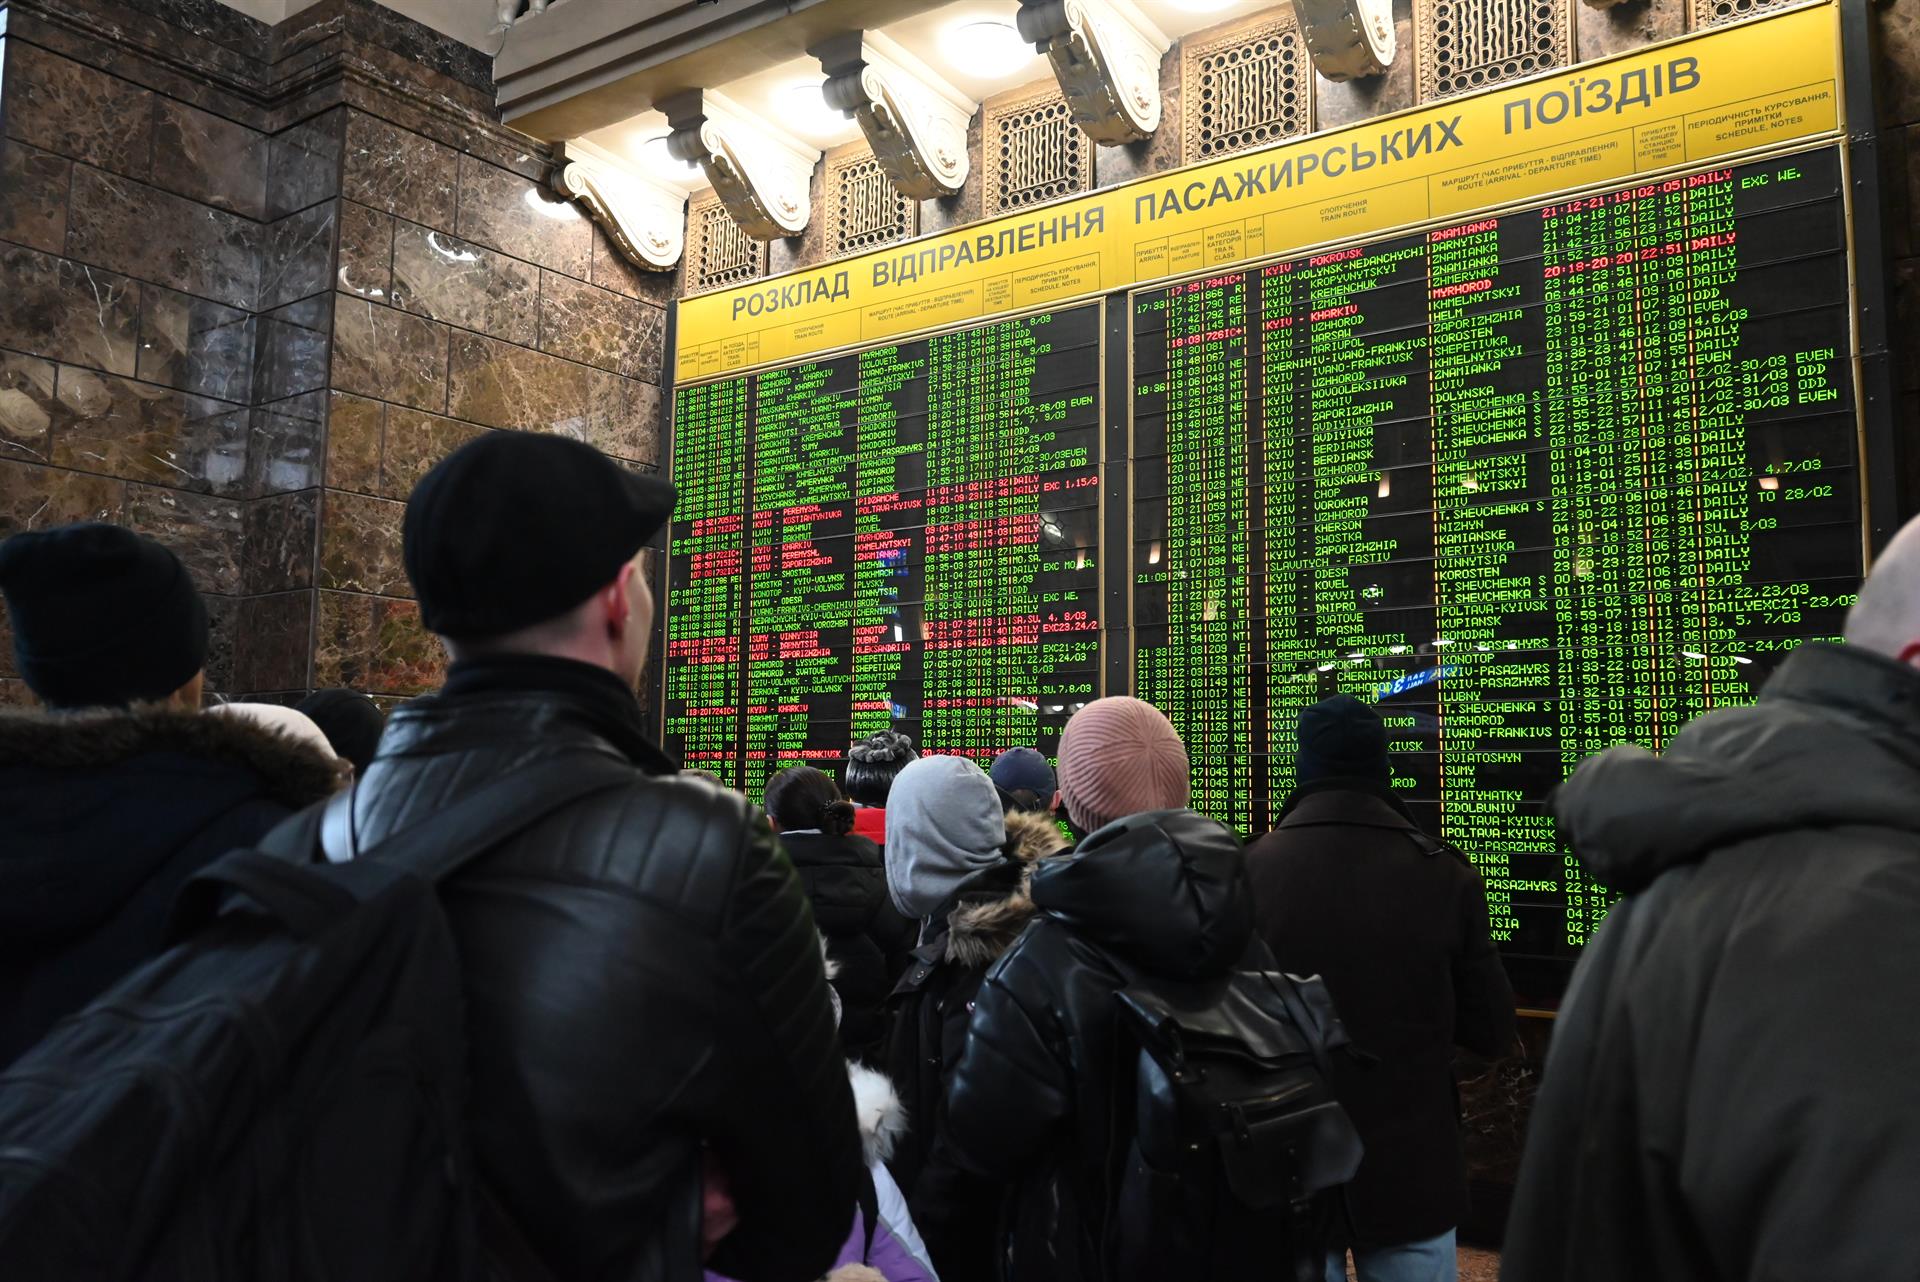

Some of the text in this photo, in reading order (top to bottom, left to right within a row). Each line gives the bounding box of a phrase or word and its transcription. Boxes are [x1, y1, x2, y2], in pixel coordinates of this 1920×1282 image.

[1688, 92, 1831, 130] ПЕРІОДИЧНІСТЬ КУРСУВАННЯ,
[1734, 112, 1782, 127] ПРИМІТКИ
[1642, 125, 1676, 136] ПРИБУТТЯ
[1716, 116, 1803, 141] SCHEDULE, NOTES
[1638, 144, 1681, 157] DESTINATION
[1442, 141, 1618, 187] МАРШРУТ (ЧАС ПРИБУТТЯ ВІДПРАВЛЕННЯ)
[1457, 154, 1601, 191] ROUTE (ARRIVAL DEPARTURE TIME)
[1688, 168, 1732, 187] DAILY
[733, 57, 1701, 320] РОЗКЛАД ВІДПРАВЛЕННЯ ПАСАЖИРСЬКИХ ПОЇЗДІВ
[1689, 181, 1733, 199] DAILY
[1742, 173, 1769, 188] EXC
[1319, 199, 1368, 215] СПОЛУЧЕННЯ
[1690, 193, 1733, 212] DAILY
[1320, 207, 1367, 223] TRAIN ROUTE
[1431, 219, 1496, 241] ZNAMIANKA
[1431, 230, 1497, 253] DARNYTSIA
[1691, 232, 1735, 250] DAILY
[1136, 245, 1167, 257] ПРИБУТТЯ
[1214, 252, 1235, 261] CLASS
[1432, 242, 1497, 264] ZNAMIANKA
[1139, 253, 1165, 264] ARRIVAL
[1265, 248, 1362, 276] KYIV POKROVSK
[1265, 246, 1423, 287] KYIV-VOLYNSK-NEDANCHYCHI
[1061, 279, 1081, 287] NOTES
[1310, 263, 1395, 289] KROPYVNYTSKYI
[1432, 266, 1498, 287] ZHMERYNKA
[1310, 278, 1376, 299] KREMENCHUK
[1432, 278, 1490, 298] MYRHOROD
[1693, 287, 1719, 301] ODD
[1311, 295, 1349, 310] IZMAIL
[1433, 285, 1520, 310] KHMELNYTSKYI
[920, 301, 949, 312] DEPARTURE
[1694, 298, 1729, 313] EVEN
[1266, 304, 1356, 330] KYIV KHARKIV
[1433, 308, 1462, 321] HELM
[1433, 308, 1522, 333] ZAPORIZHZHIA
[1310, 314, 1363, 332] UZHHOROD
[809, 330, 823, 338] ROUTE
[1311, 327, 1350, 343] WARSAW
[1434, 326, 1492, 345] KOROSTEN
[1311, 337, 1363, 354] MARIUPOL
[1434, 335, 1507, 356] SHEPETIVKA
[862, 346, 897, 360] MYRHOROD
[1267, 337, 1426, 373] CHERNIHIV-IVANO-FRANKIVS
[862, 355, 897, 369] VOLOVETS
[1312, 351, 1412, 376] IVANO-FRANKIVSK
[760, 363, 816, 381] KHARKIV LVIV
[862, 382, 901, 396] VINNYTSIA
[1312, 375, 1406, 399] NOVOOLEKSIIVKA
[1435, 378, 1464, 391] LVIV
[1435, 385, 1494, 403] DOLYNSKA
[759, 393, 840, 415] TRUSKAVETS KHARKIV
[1312, 395, 1351, 410] RAKHIV
[1312, 400, 1392, 421] ZAPORIZHZHIA
[861, 428, 896, 441] KHODORIV
[1313, 426, 1372, 443] AVDIYIVKA
[801, 441, 818, 451] SUMY
[1437, 454, 1525, 473] KHMELNYTSKYI
[1313, 471, 1380, 488] TRUSKAVETS
[1013, 484, 1038, 495] DAILY
[1044, 481, 1059, 490] EXC
[1314, 487, 1340, 499] CHOP
[859, 493, 899, 505] PIDZAMCHE
[1702, 485, 1831, 508] DAILY TO 28/02
[755, 504, 820, 519] KYIV PEREMYSHL
[859, 514, 881, 523] KOVEL
[783, 523, 812, 533] BAKHMUT
[1314, 520, 1361, 533] KHERSON
[1438, 519, 1482, 532] NIZHYN
[1739, 517, 1775, 531] 8/03
[1314, 531, 1361, 544] SHOSTKA
[1439, 529, 1505, 544] KAMIANSKE
[1439, 540, 1513, 556] VERTIYIVKA
[1270, 551, 1389, 571] SLAVUTYCH FASTIV
[1439, 554, 1506, 568] VINNYTSIA
[1315, 567, 1348, 579] ODESA
[1315, 578, 1348, 590] KOVEL
[753, 595, 801, 607] KYIV ODESA
[1316, 601, 1355, 612] DNIPRO
[1441, 600, 1547, 616] POLTAVA-KYIVSK
[1316, 613, 1362, 624] SVATOVE
[1441, 615, 1500, 628] KUPIANSK
[1316, 624, 1363, 635] POPASNA
[779, 648, 830, 658] ZAPORIZHZHIA
[856, 643, 910, 653] OLEKSANDRIIA
[796, 657, 838, 666] LYSYCHANSK
[856, 653, 901, 662] SHEPETIVKA
[855, 672, 896, 681] DARNYTSIA
[1442, 676, 1549, 689] KYIV-PASAZHYRS
[750, 687, 778, 695] ZERNOVE
[855, 691, 891, 700] POPILNIA
[1443, 691, 1480, 701] LUBNY
[778, 695, 799, 703] RIVNE
[1445, 726, 1551, 738] IVANO-FRANKIVS
[1444, 752, 1520, 762] SVIATOSHYN
[1445, 765, 1474, 775] SUMY
[1445, 790, 1521, 800] PIATYHATKY
[1446, 803, 1514, 813] ZDOLBUNIV
